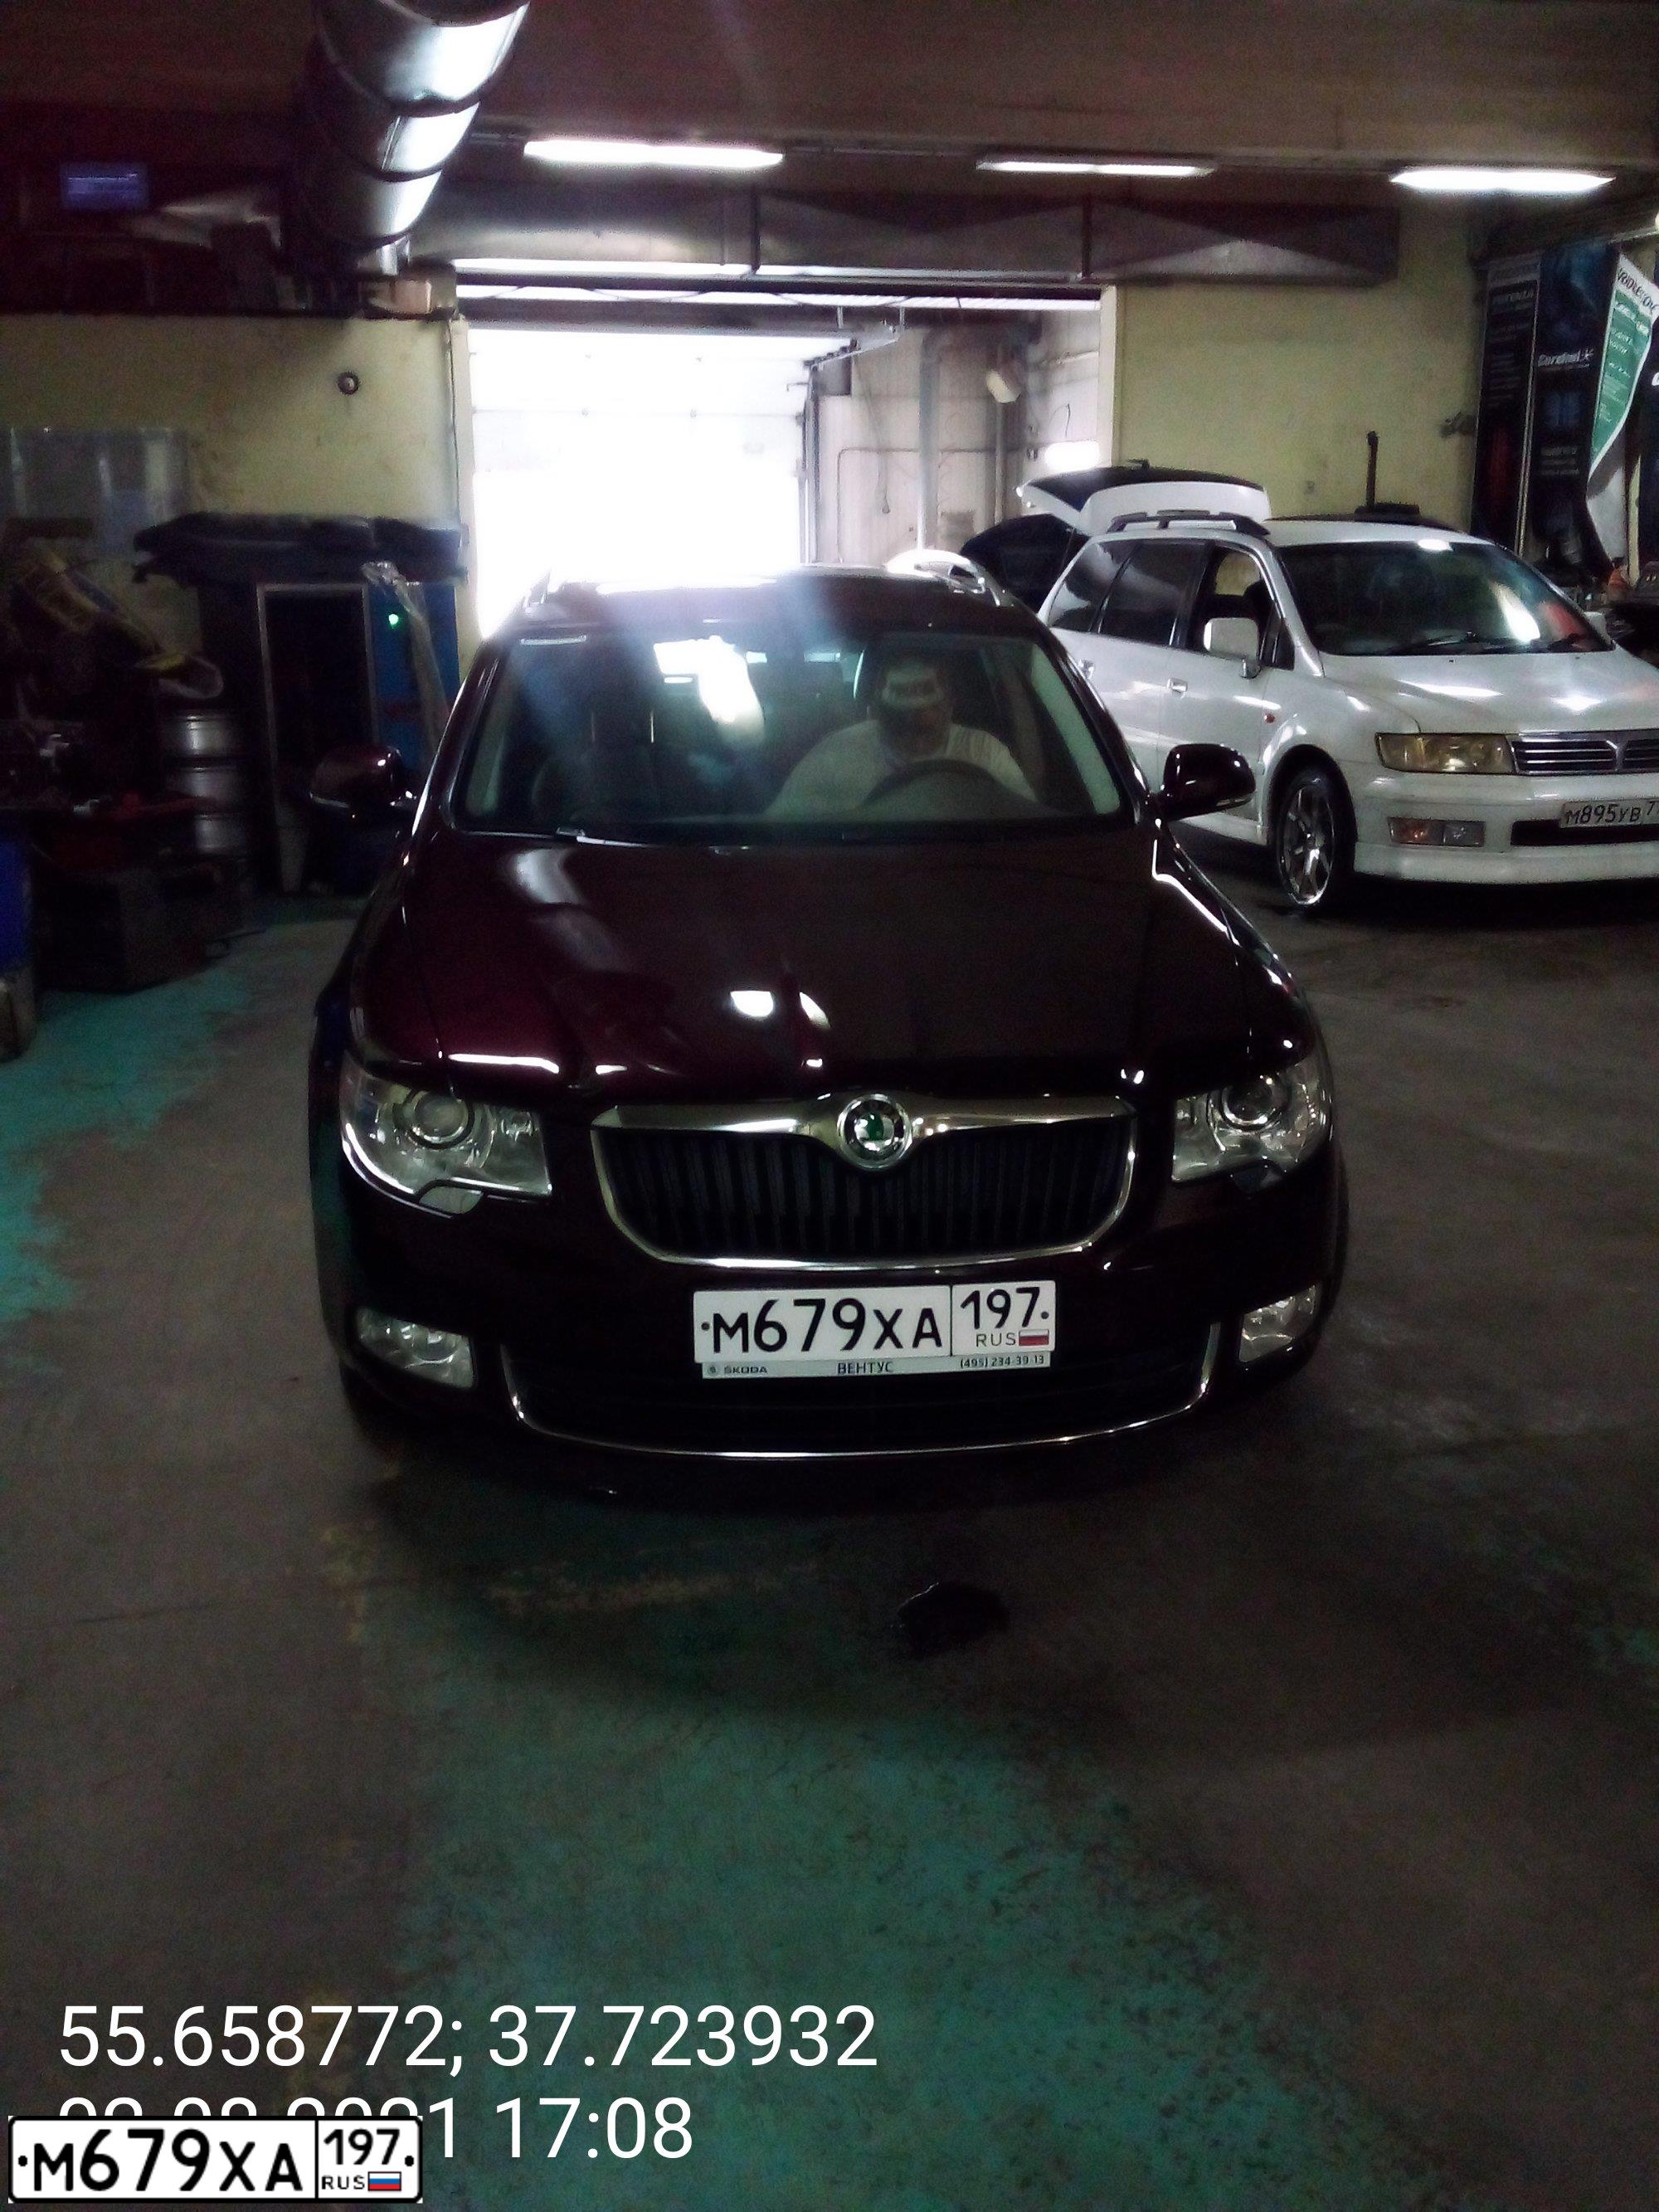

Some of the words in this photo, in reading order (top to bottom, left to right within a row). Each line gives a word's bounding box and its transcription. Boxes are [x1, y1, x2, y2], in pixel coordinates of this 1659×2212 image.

[961, 1287, 1040, 1329] 197
[713, 1298, 942, 1353] М679ХА
[975, 1333, 1016, 1347] RUS
[837, 1361, 893, 1375] ВЕНТУС
